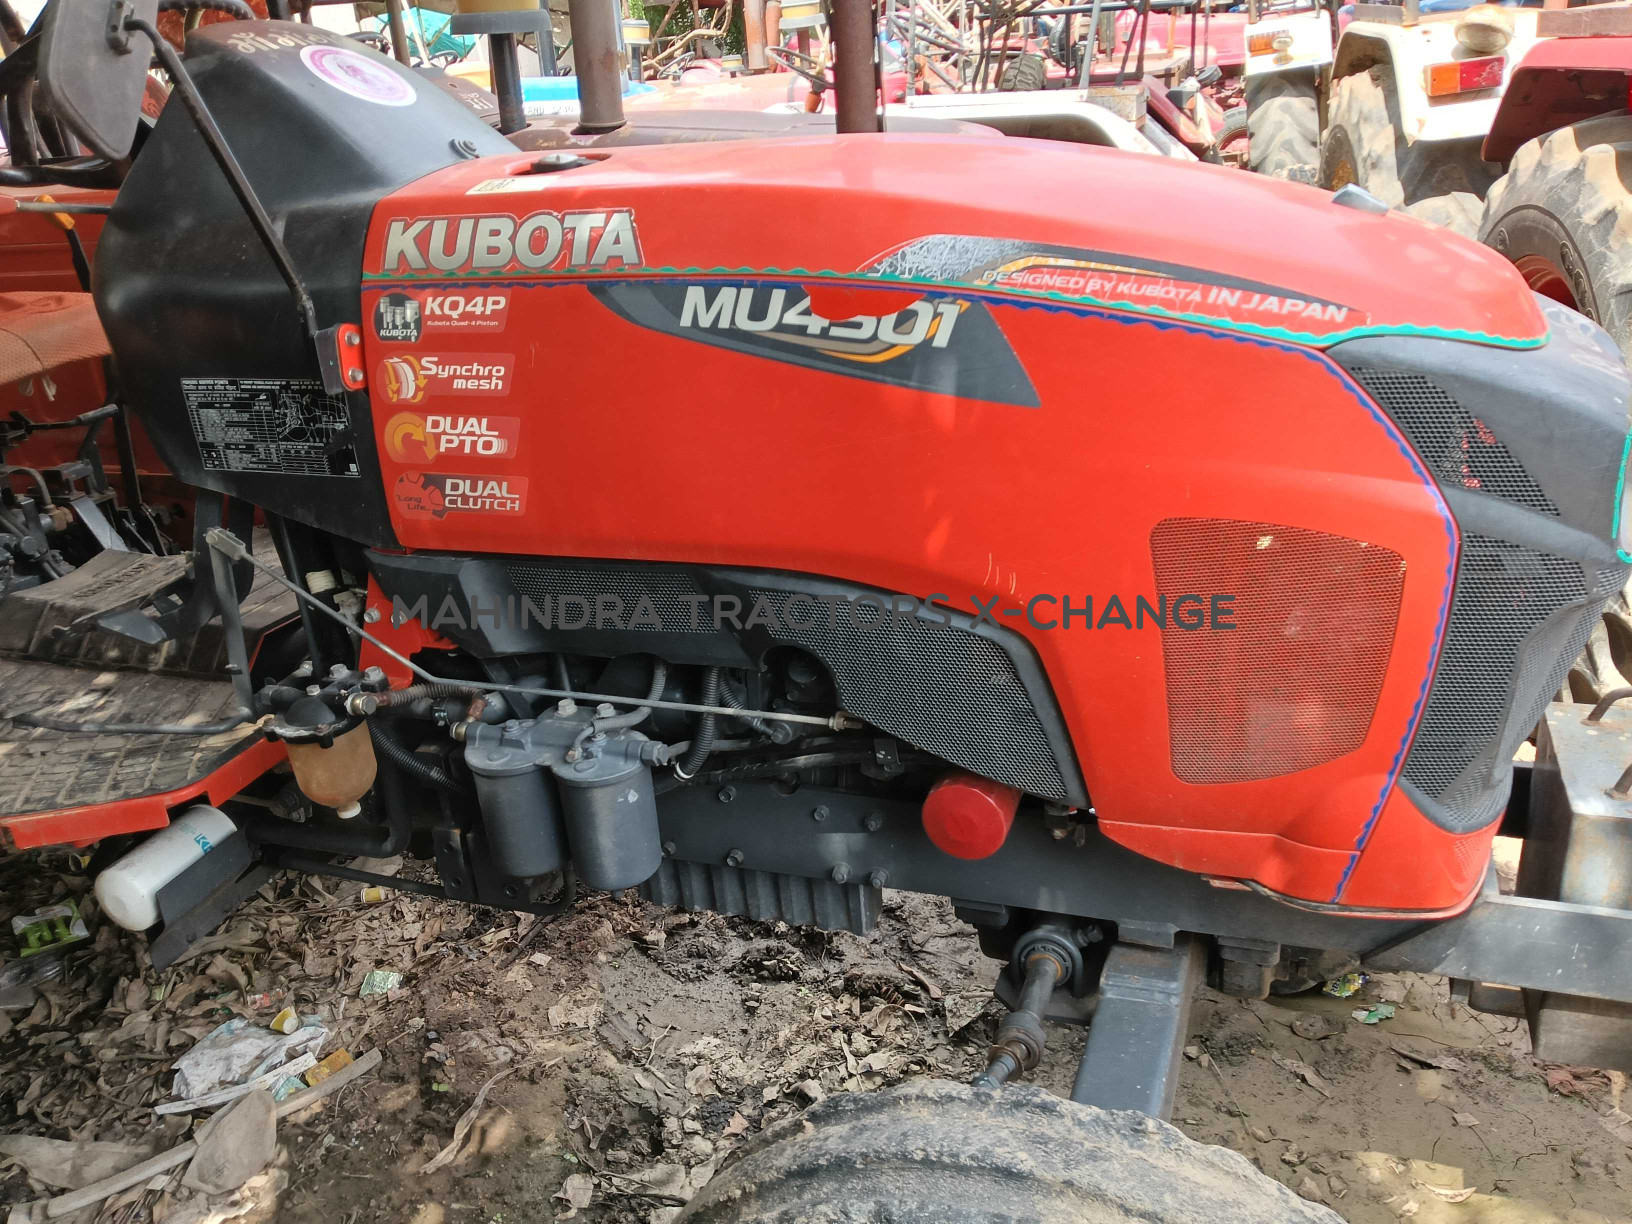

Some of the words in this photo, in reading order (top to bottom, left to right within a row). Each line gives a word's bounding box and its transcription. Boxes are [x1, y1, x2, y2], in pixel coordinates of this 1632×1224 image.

[384, 212, 640, 270] KUBOTA
[982, 270, 1085, 290] DESIGNED
[1086, 278, 1114, 294] BY
[1116, 281, 1202, 302] KUBOTA
[1207, 285, 1242, 307] IN
[1241, 293, 1349, 323] JAPAN
[424, 296, 507, 319] KQ4P
[380, 328, 418, 337] KUBOTA
[419, 356, 506, 378] Synchro
[452, 374, 503, 390] mesh
[425, 415, 499, 436] DUAL
[439, 435, 499, 455] PTO
[445, 478, 520, 498] DUAL
[396, 494, 422, 504] Long
[444, 496, 520, 511] CLUTCH
